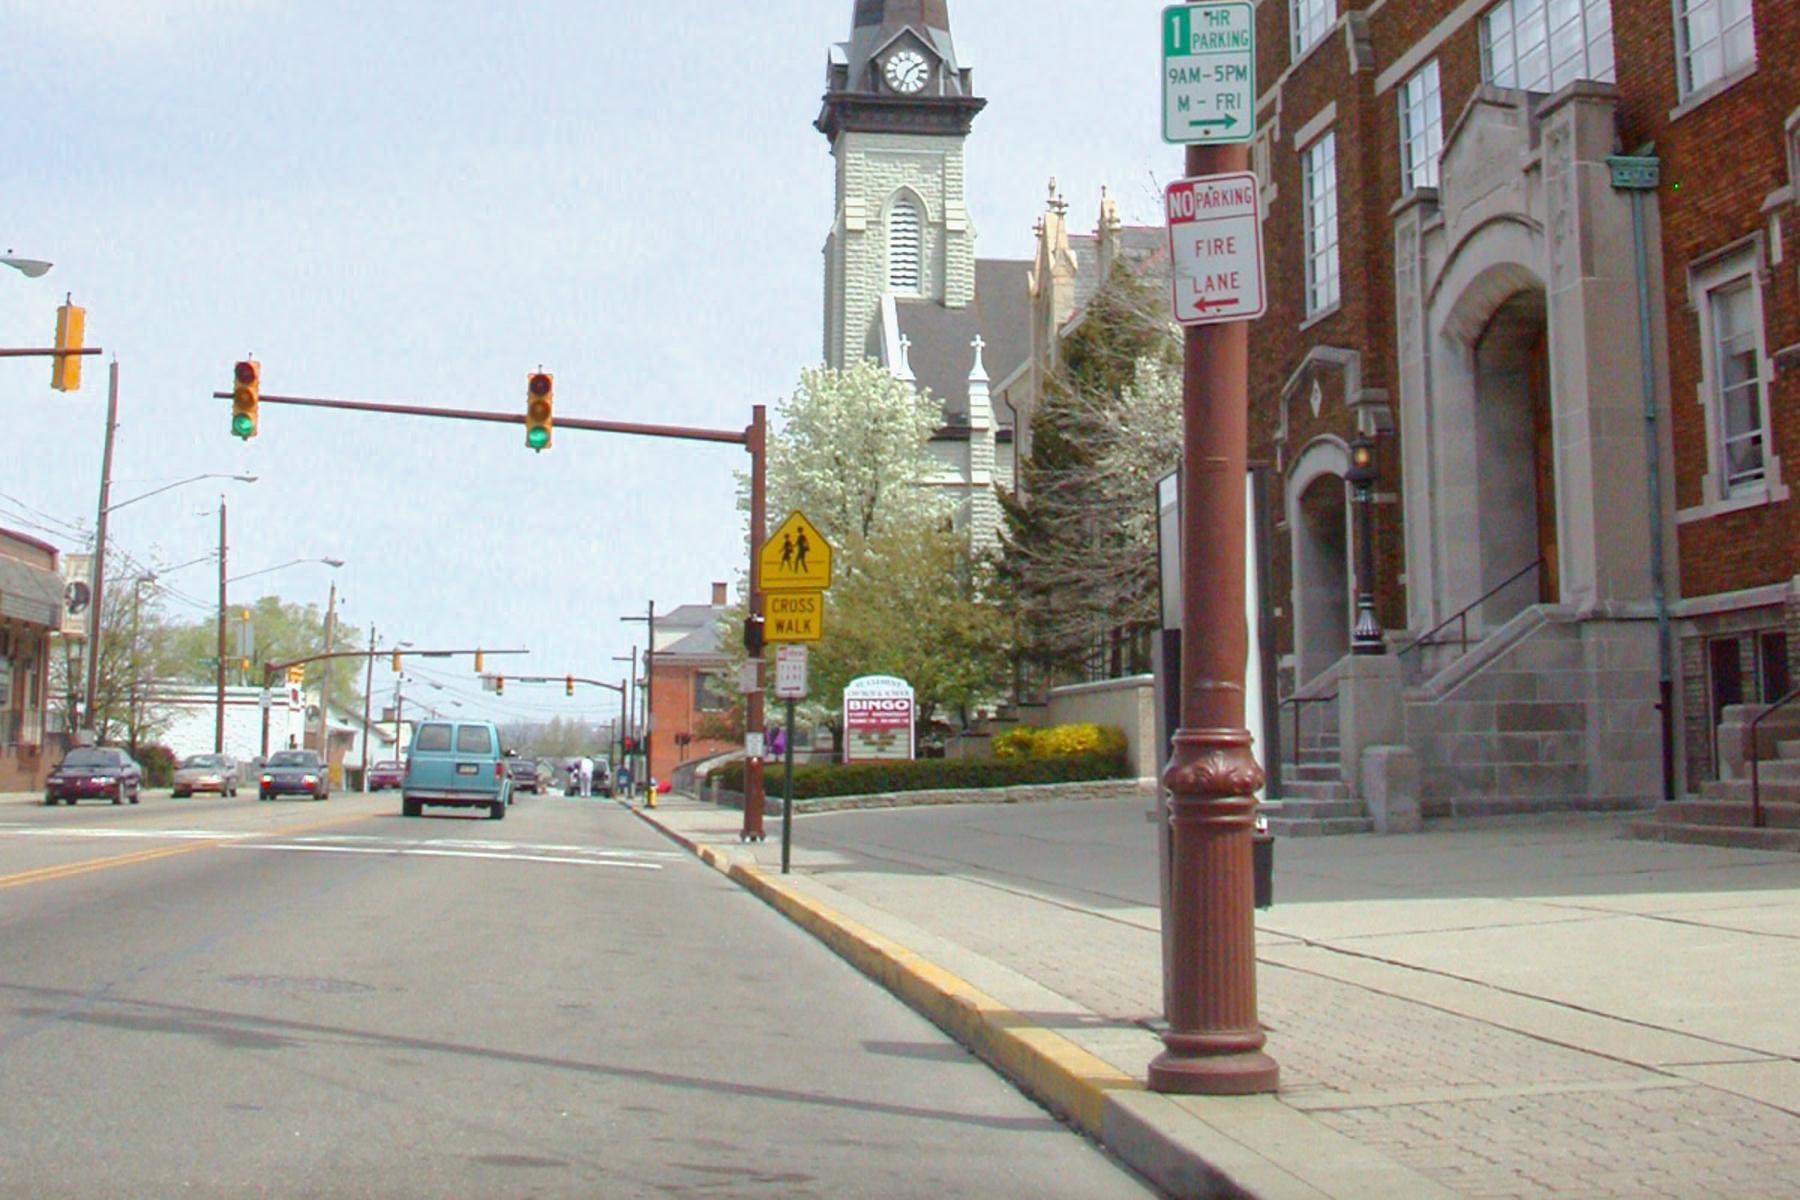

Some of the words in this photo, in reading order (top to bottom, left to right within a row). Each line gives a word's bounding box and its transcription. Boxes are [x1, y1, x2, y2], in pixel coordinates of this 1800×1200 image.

[1172, 15, 1180, 49] 1
[1209, 9, 1231, 27] HR
[1192, 30, 1249, 50] PARKING
[1177, 94, 1190, 113] M
[1215, 92, 1241, 110] FRI
[1169, 189, 1194, 219] NO
[1195, 186, 1252, 210] PARKING
[1195, 236, 1237, 258] FIRE
[1193, 272, 1240, 294] LANE
[772, 597, 815, 613] CROSS
[775, 618, 812, 634] WALK
[849, 700, 909, 710] BINGO
